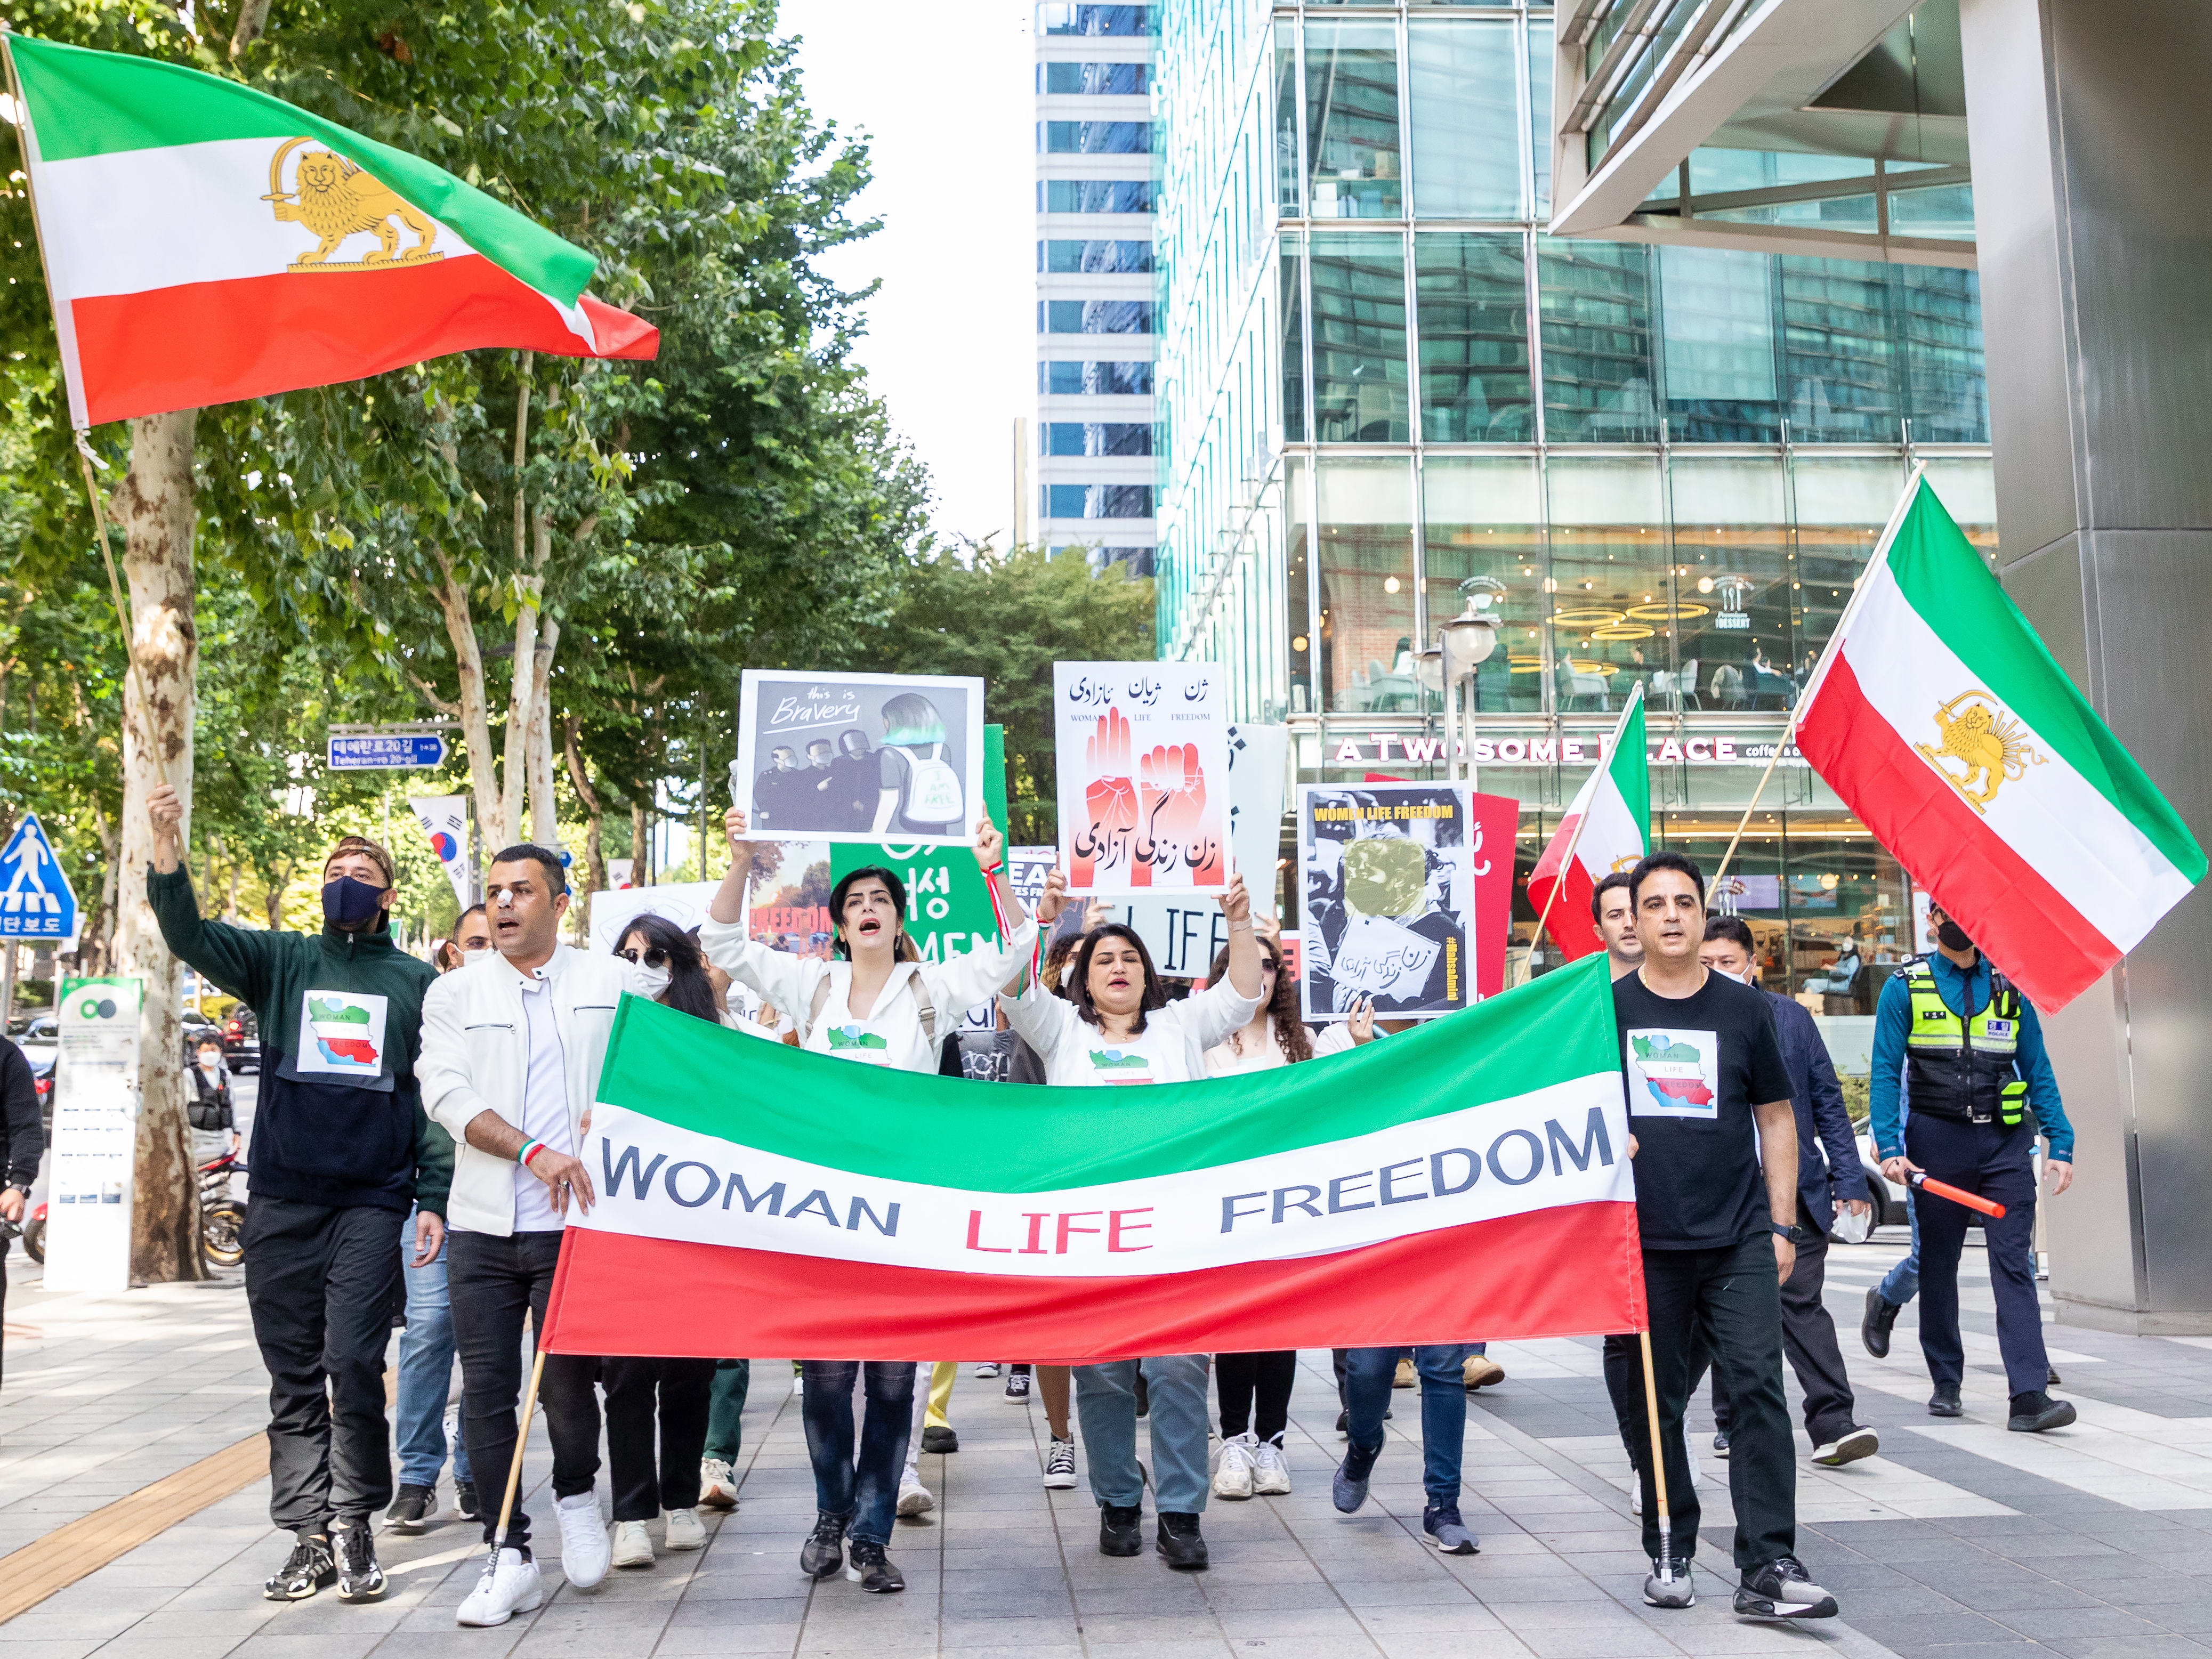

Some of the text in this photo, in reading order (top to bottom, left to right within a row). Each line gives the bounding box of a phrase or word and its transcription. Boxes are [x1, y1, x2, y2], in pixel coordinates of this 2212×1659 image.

[807, 685, 855, 700] this is
[1184, 679, 1208, 702] ژن
[1335, 738, 1363, 762] A
[1597, 733, 1738, 762] PACE
[1746, 744, 1782, 757] coffe
[1314, 805, 1454, 822] WOMEN LIFE FREEDOM
[1185, 836, 1216, 872] زن
[0, 916, 61, 933] 단보도
[1127, 905, 1229, 971] IFE
[602, 1106, 1615, 1255] WOMAN LIFE FREEDOM
